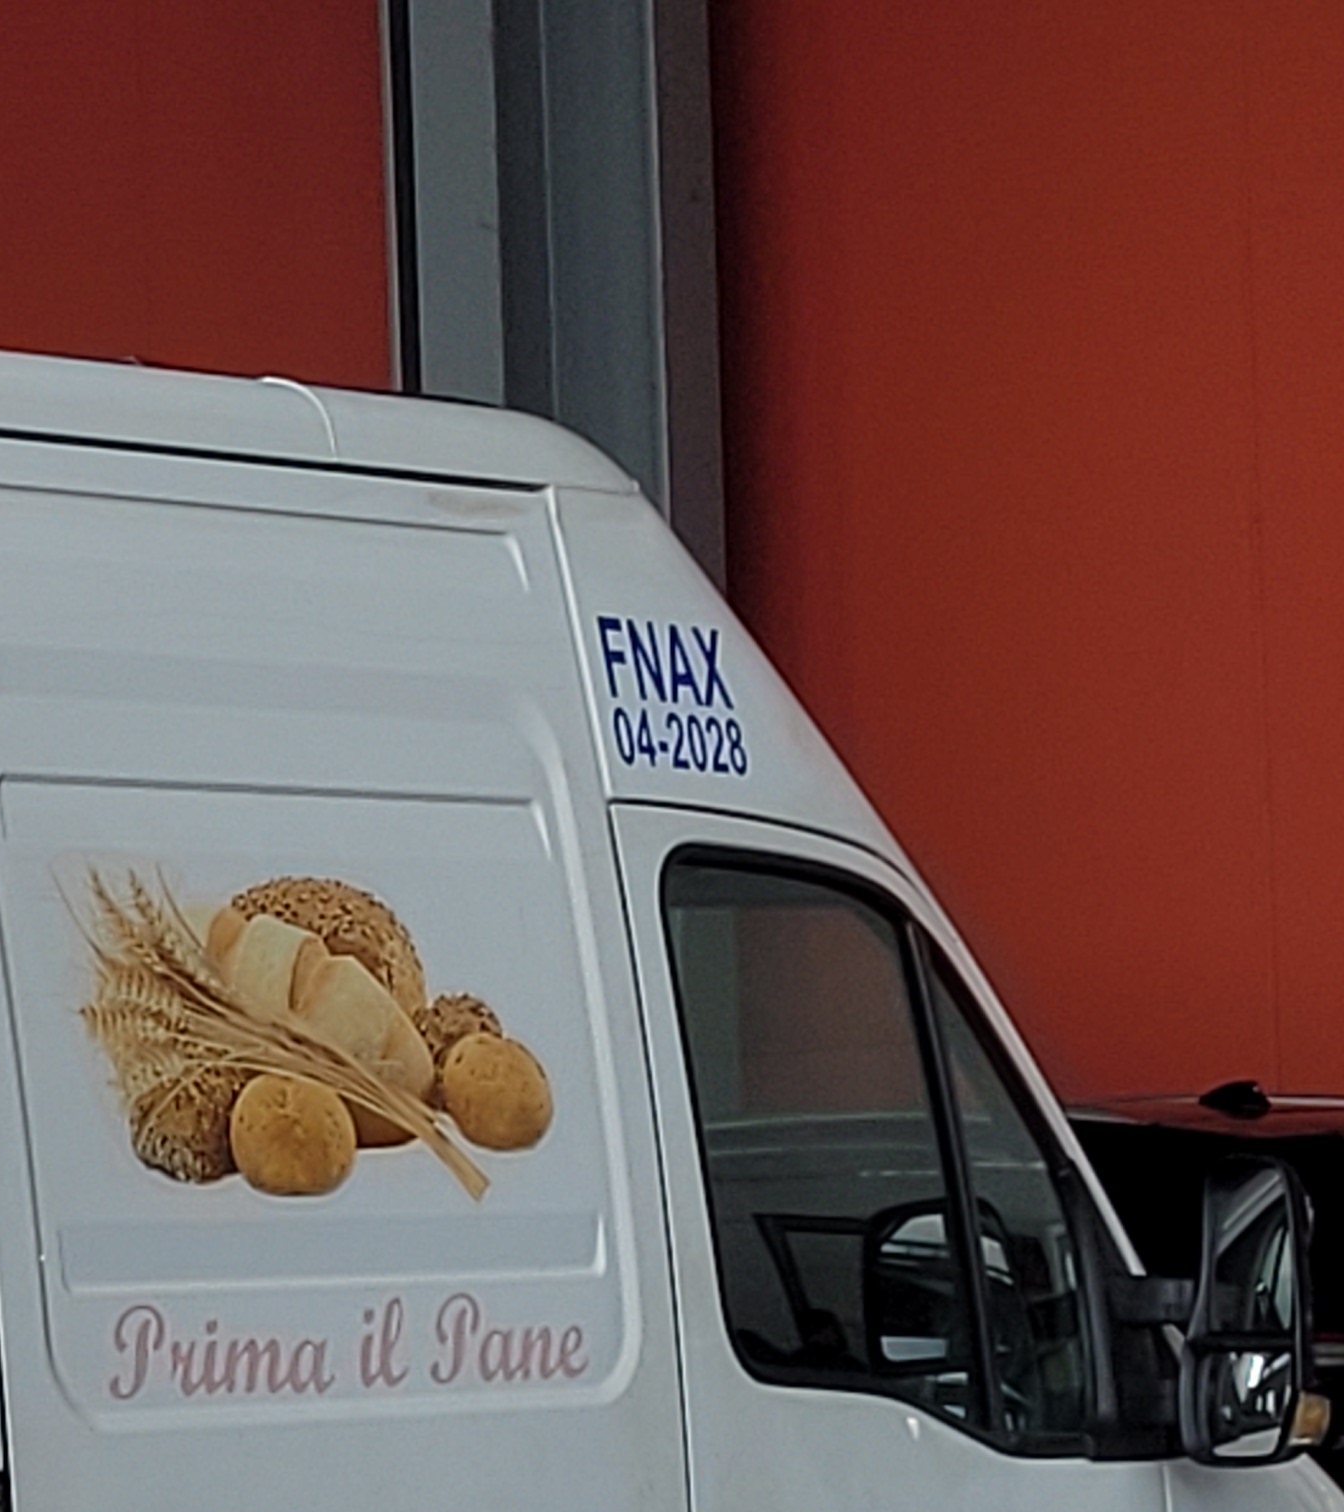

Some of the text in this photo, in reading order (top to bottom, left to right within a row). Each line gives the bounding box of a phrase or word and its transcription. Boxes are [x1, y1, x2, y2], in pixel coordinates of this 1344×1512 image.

[597, 615, 734, 711] FNAX
[613, 706, 748, 777] 04-2028
[109, 1292, 590, 1400] Prima il Pane
